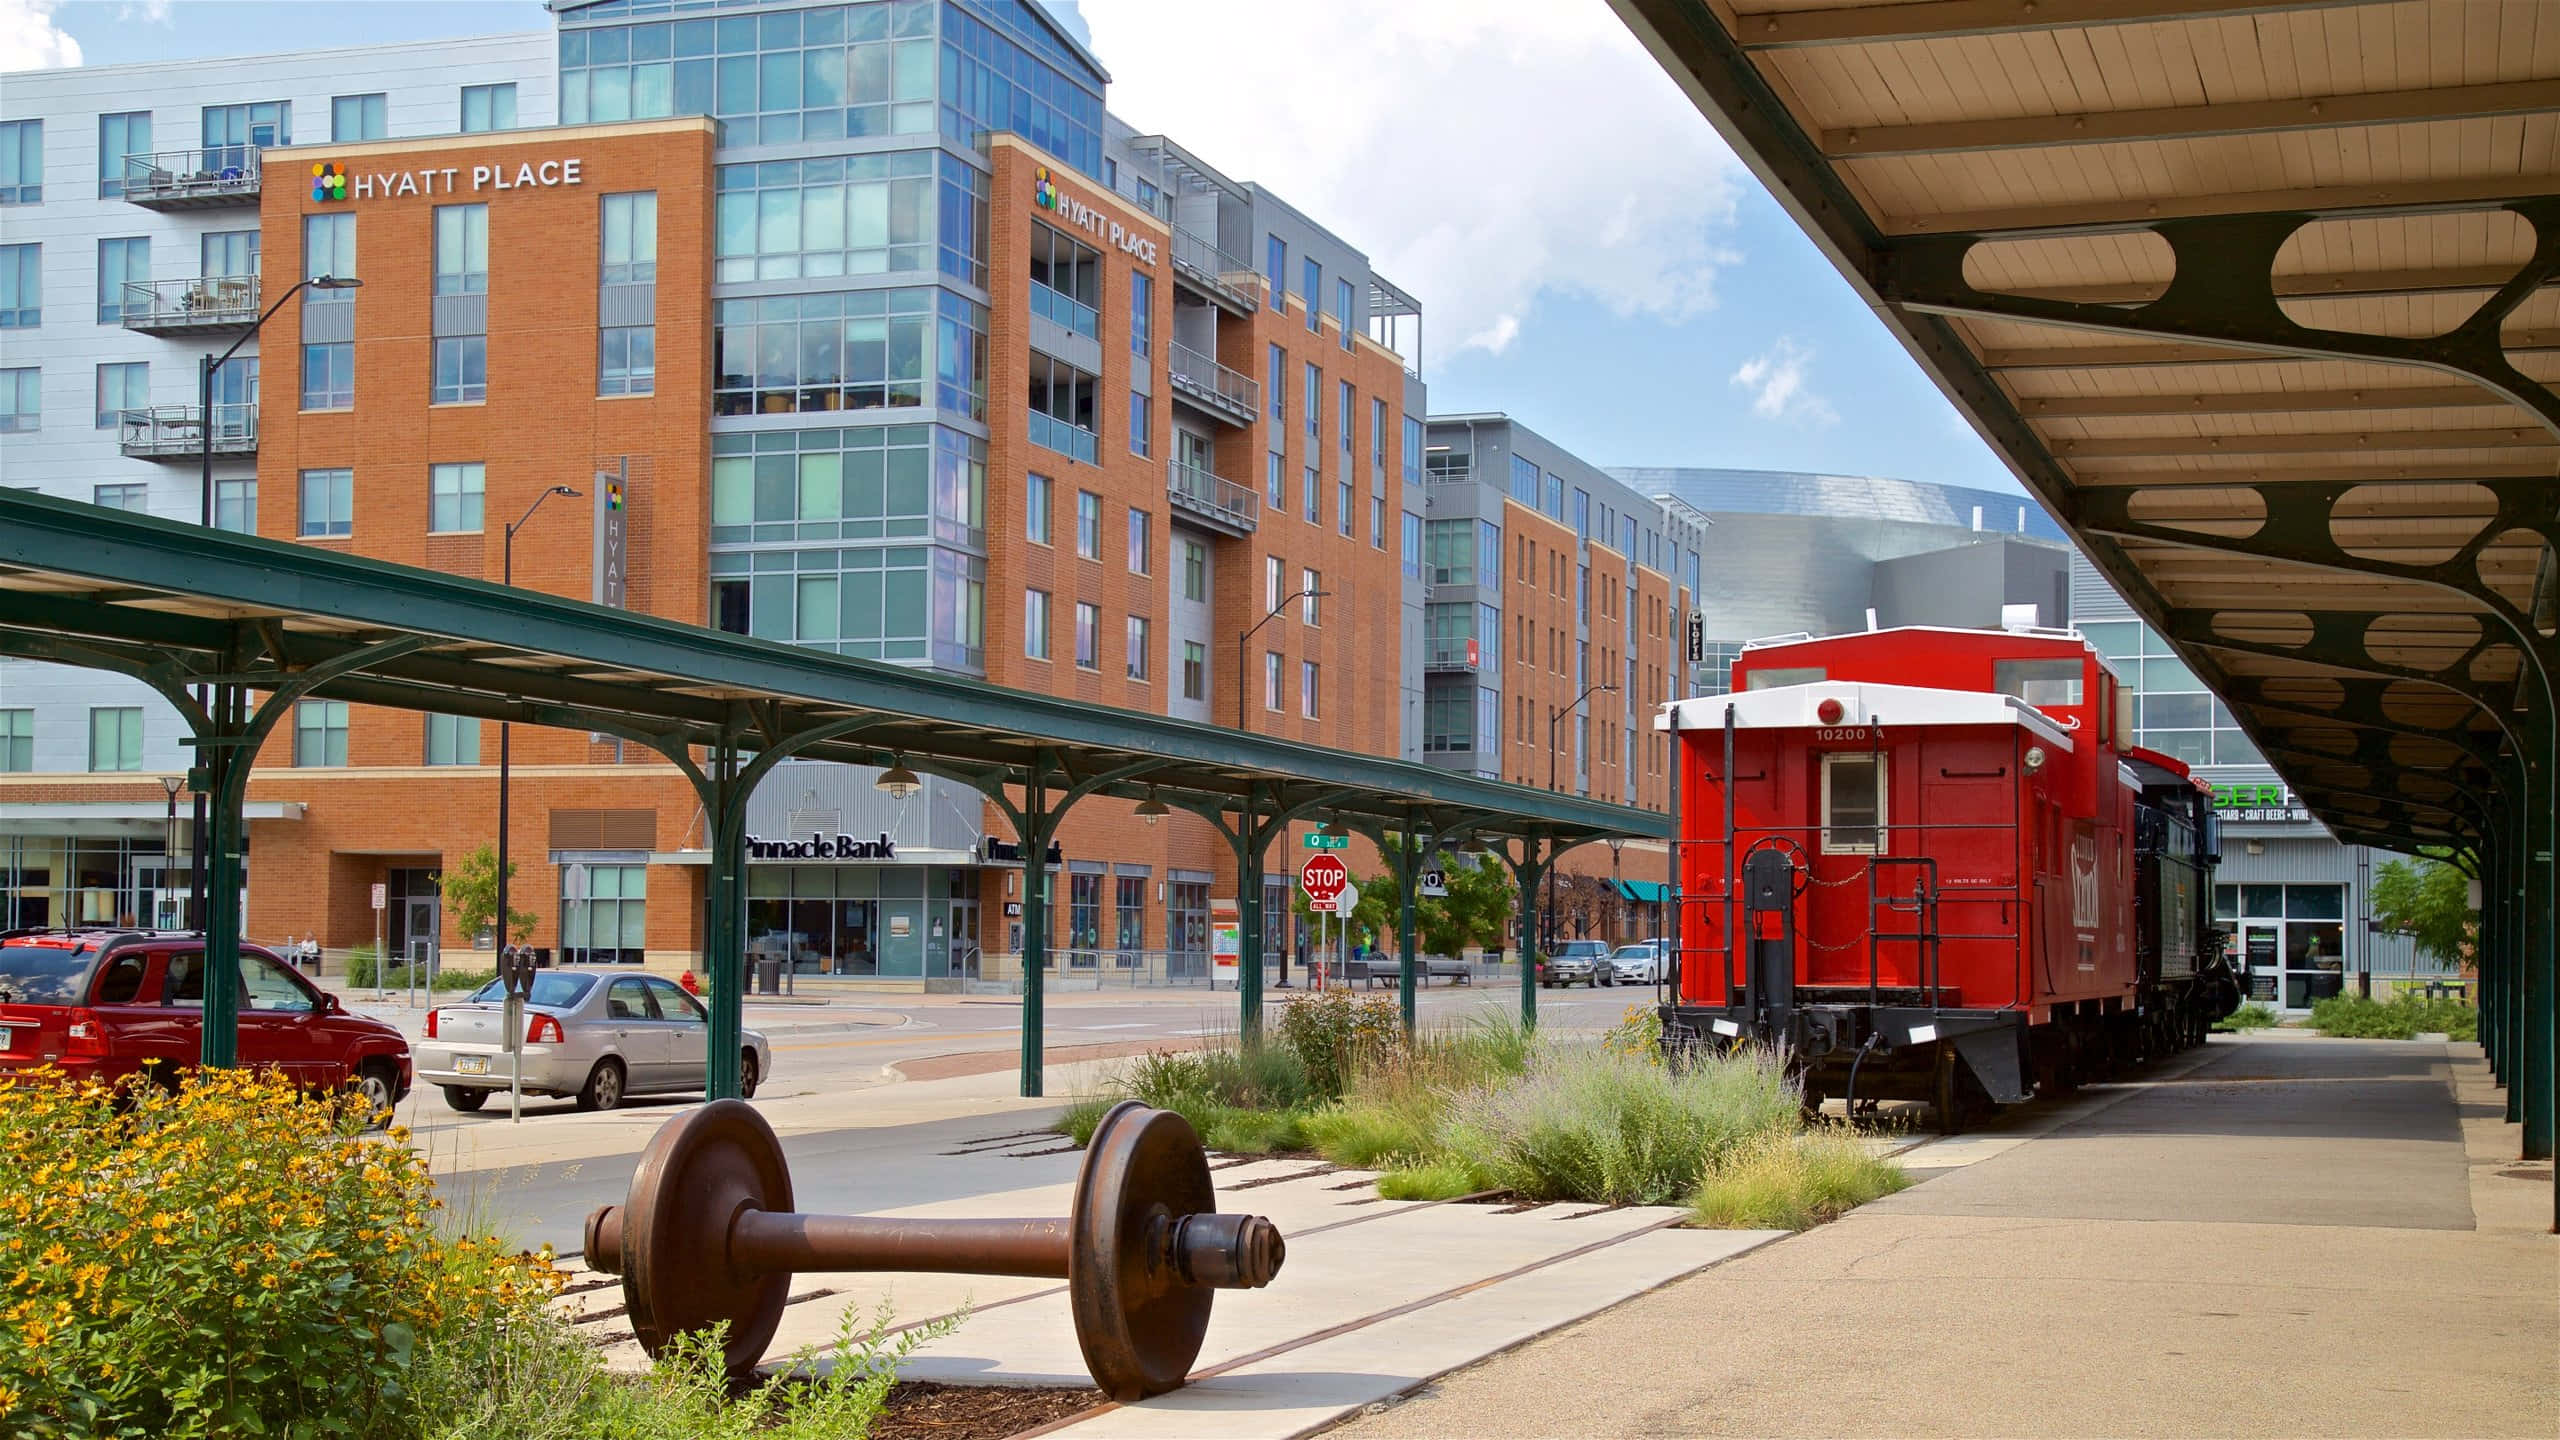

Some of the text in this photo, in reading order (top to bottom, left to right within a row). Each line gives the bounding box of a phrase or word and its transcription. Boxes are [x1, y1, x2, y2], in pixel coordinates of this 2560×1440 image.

[354, 159, 581, 199] HYATT PLACE
[1057, 191, 1157, 266] HYATT PLACE
[607, 519, 619, 608] HYAT
[1815, 728, 1865, 741] 10200
[2245, 809, 2265, 821] CRAFT
[2266, 809, 2286, 821] BEERS
[835, 832, 895, 859] Bank
[1311, 835, 1320, 846] Q
[1305, 869, 1344, 887] STOP
[1007, 903, 1021, 915] ATM
